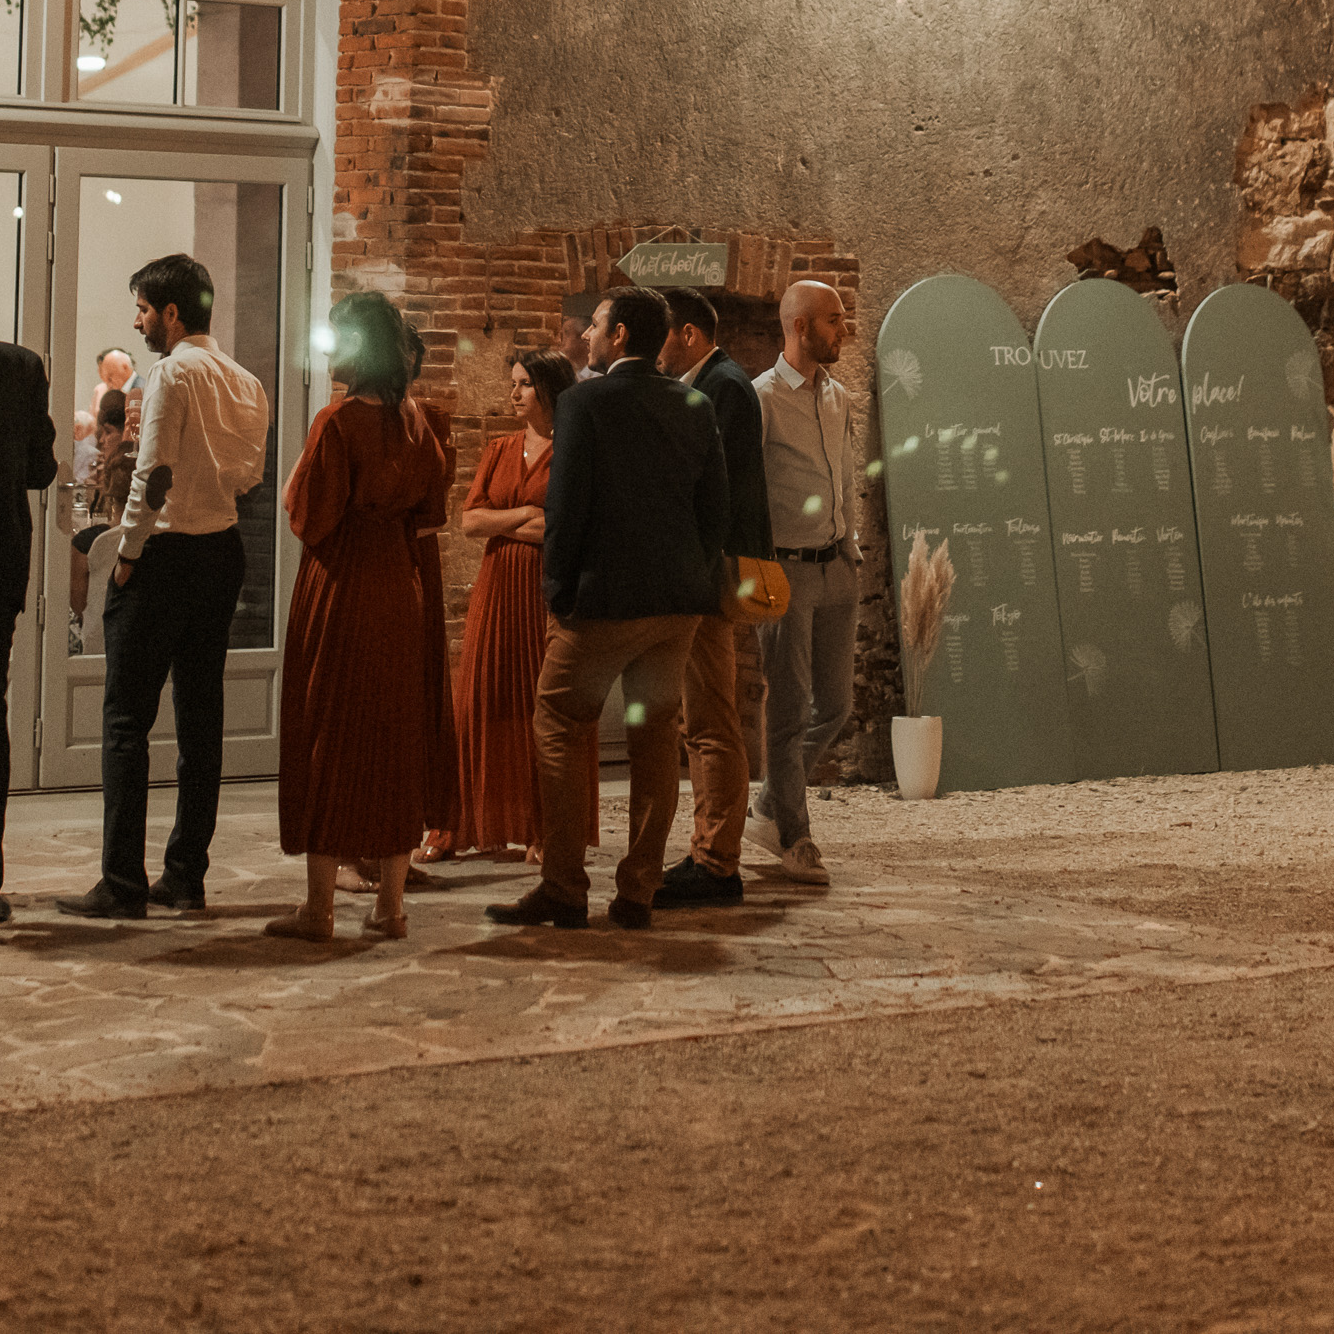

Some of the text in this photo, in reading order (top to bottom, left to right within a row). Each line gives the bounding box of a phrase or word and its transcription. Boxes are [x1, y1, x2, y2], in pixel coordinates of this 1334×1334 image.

[1127, 371, 1245, 415] Votre place!
[990, 603, 1022, 627] Tokyo
